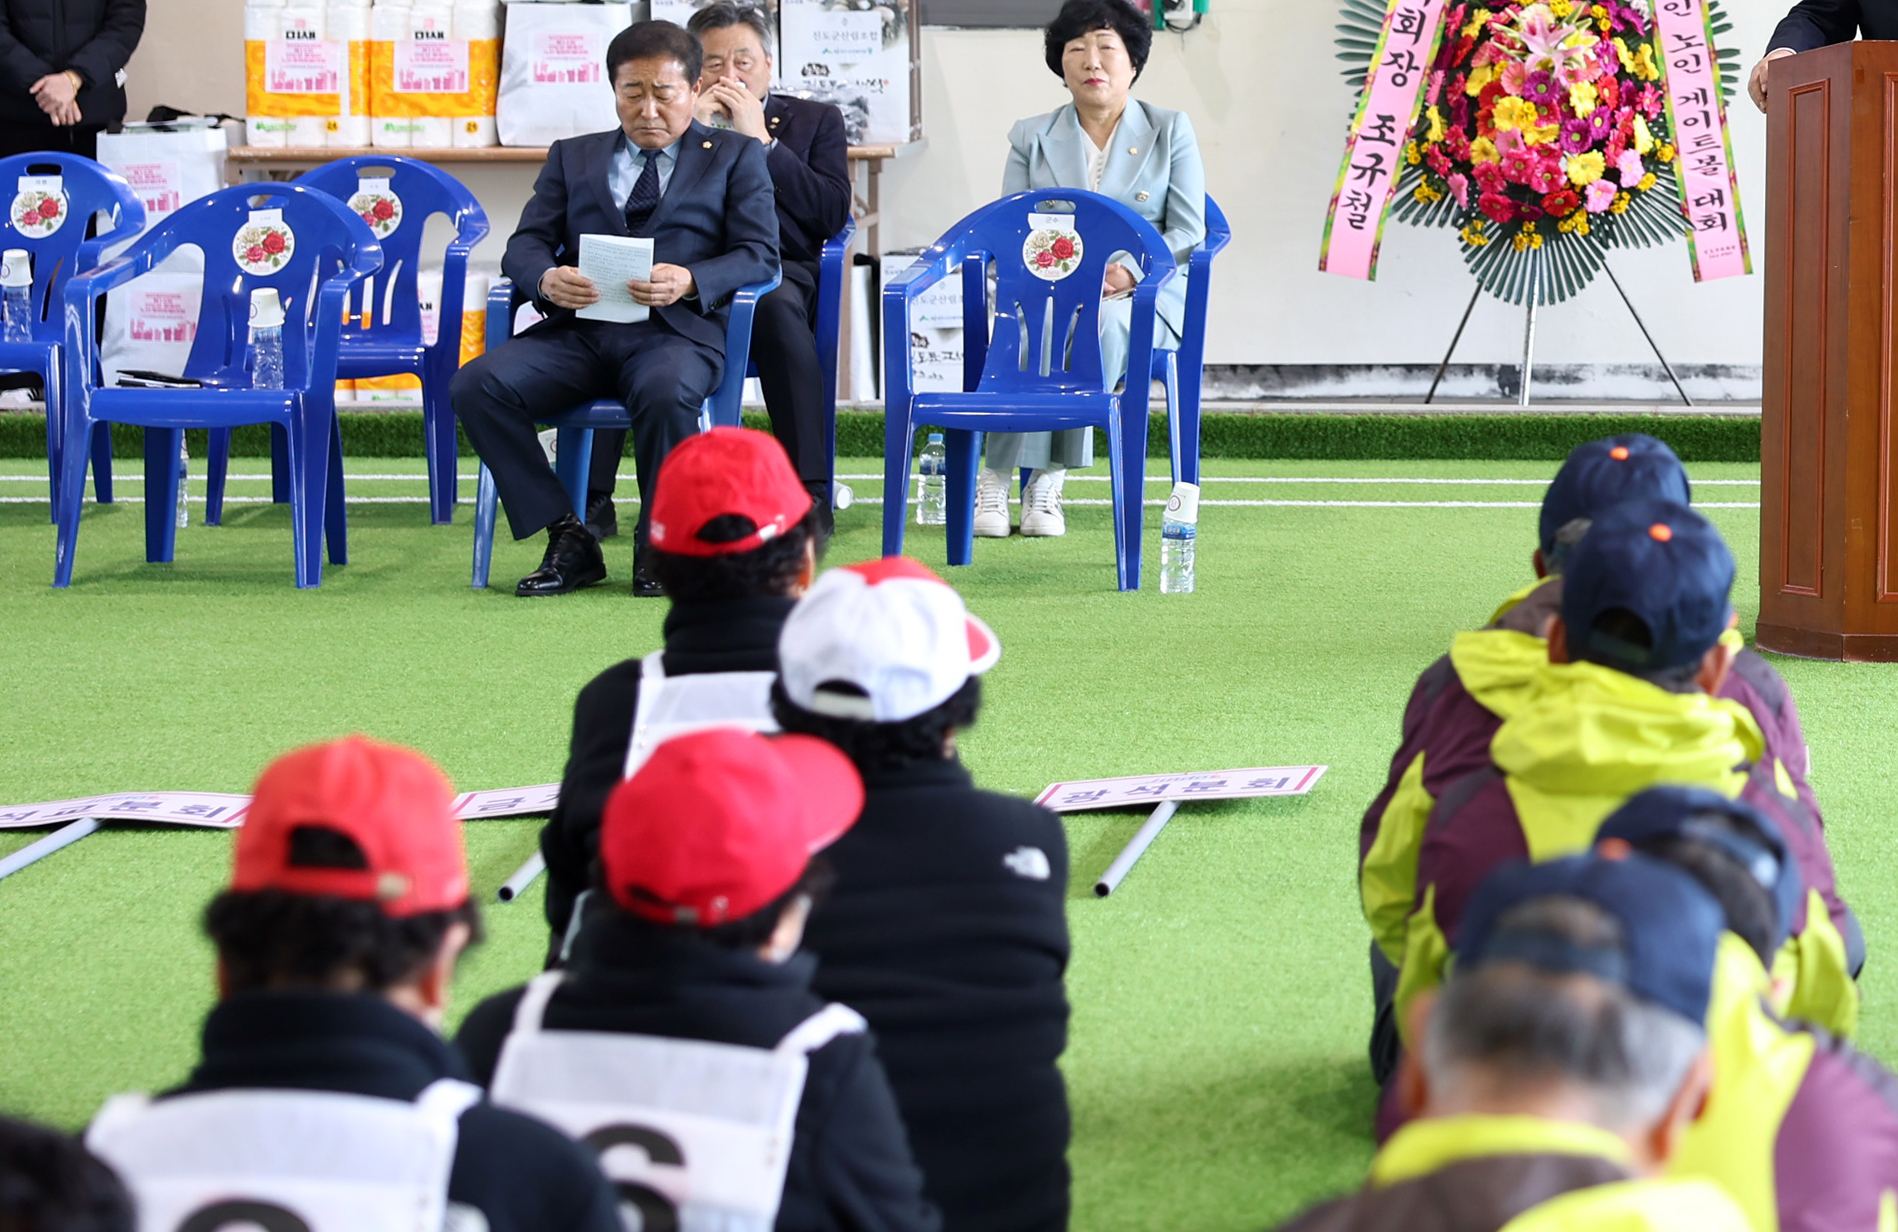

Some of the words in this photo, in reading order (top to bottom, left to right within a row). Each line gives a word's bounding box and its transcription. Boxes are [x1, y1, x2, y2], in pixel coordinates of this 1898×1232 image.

[813, 30, 878, 41] 진도군산림조합
[1669, 34, 1704, 74] 노인
[1678, 88, 1722, 176] 게이트볼
[1341, 114, 1396, 231] 조규철
[1693, 188, 1727, 232] 대회
